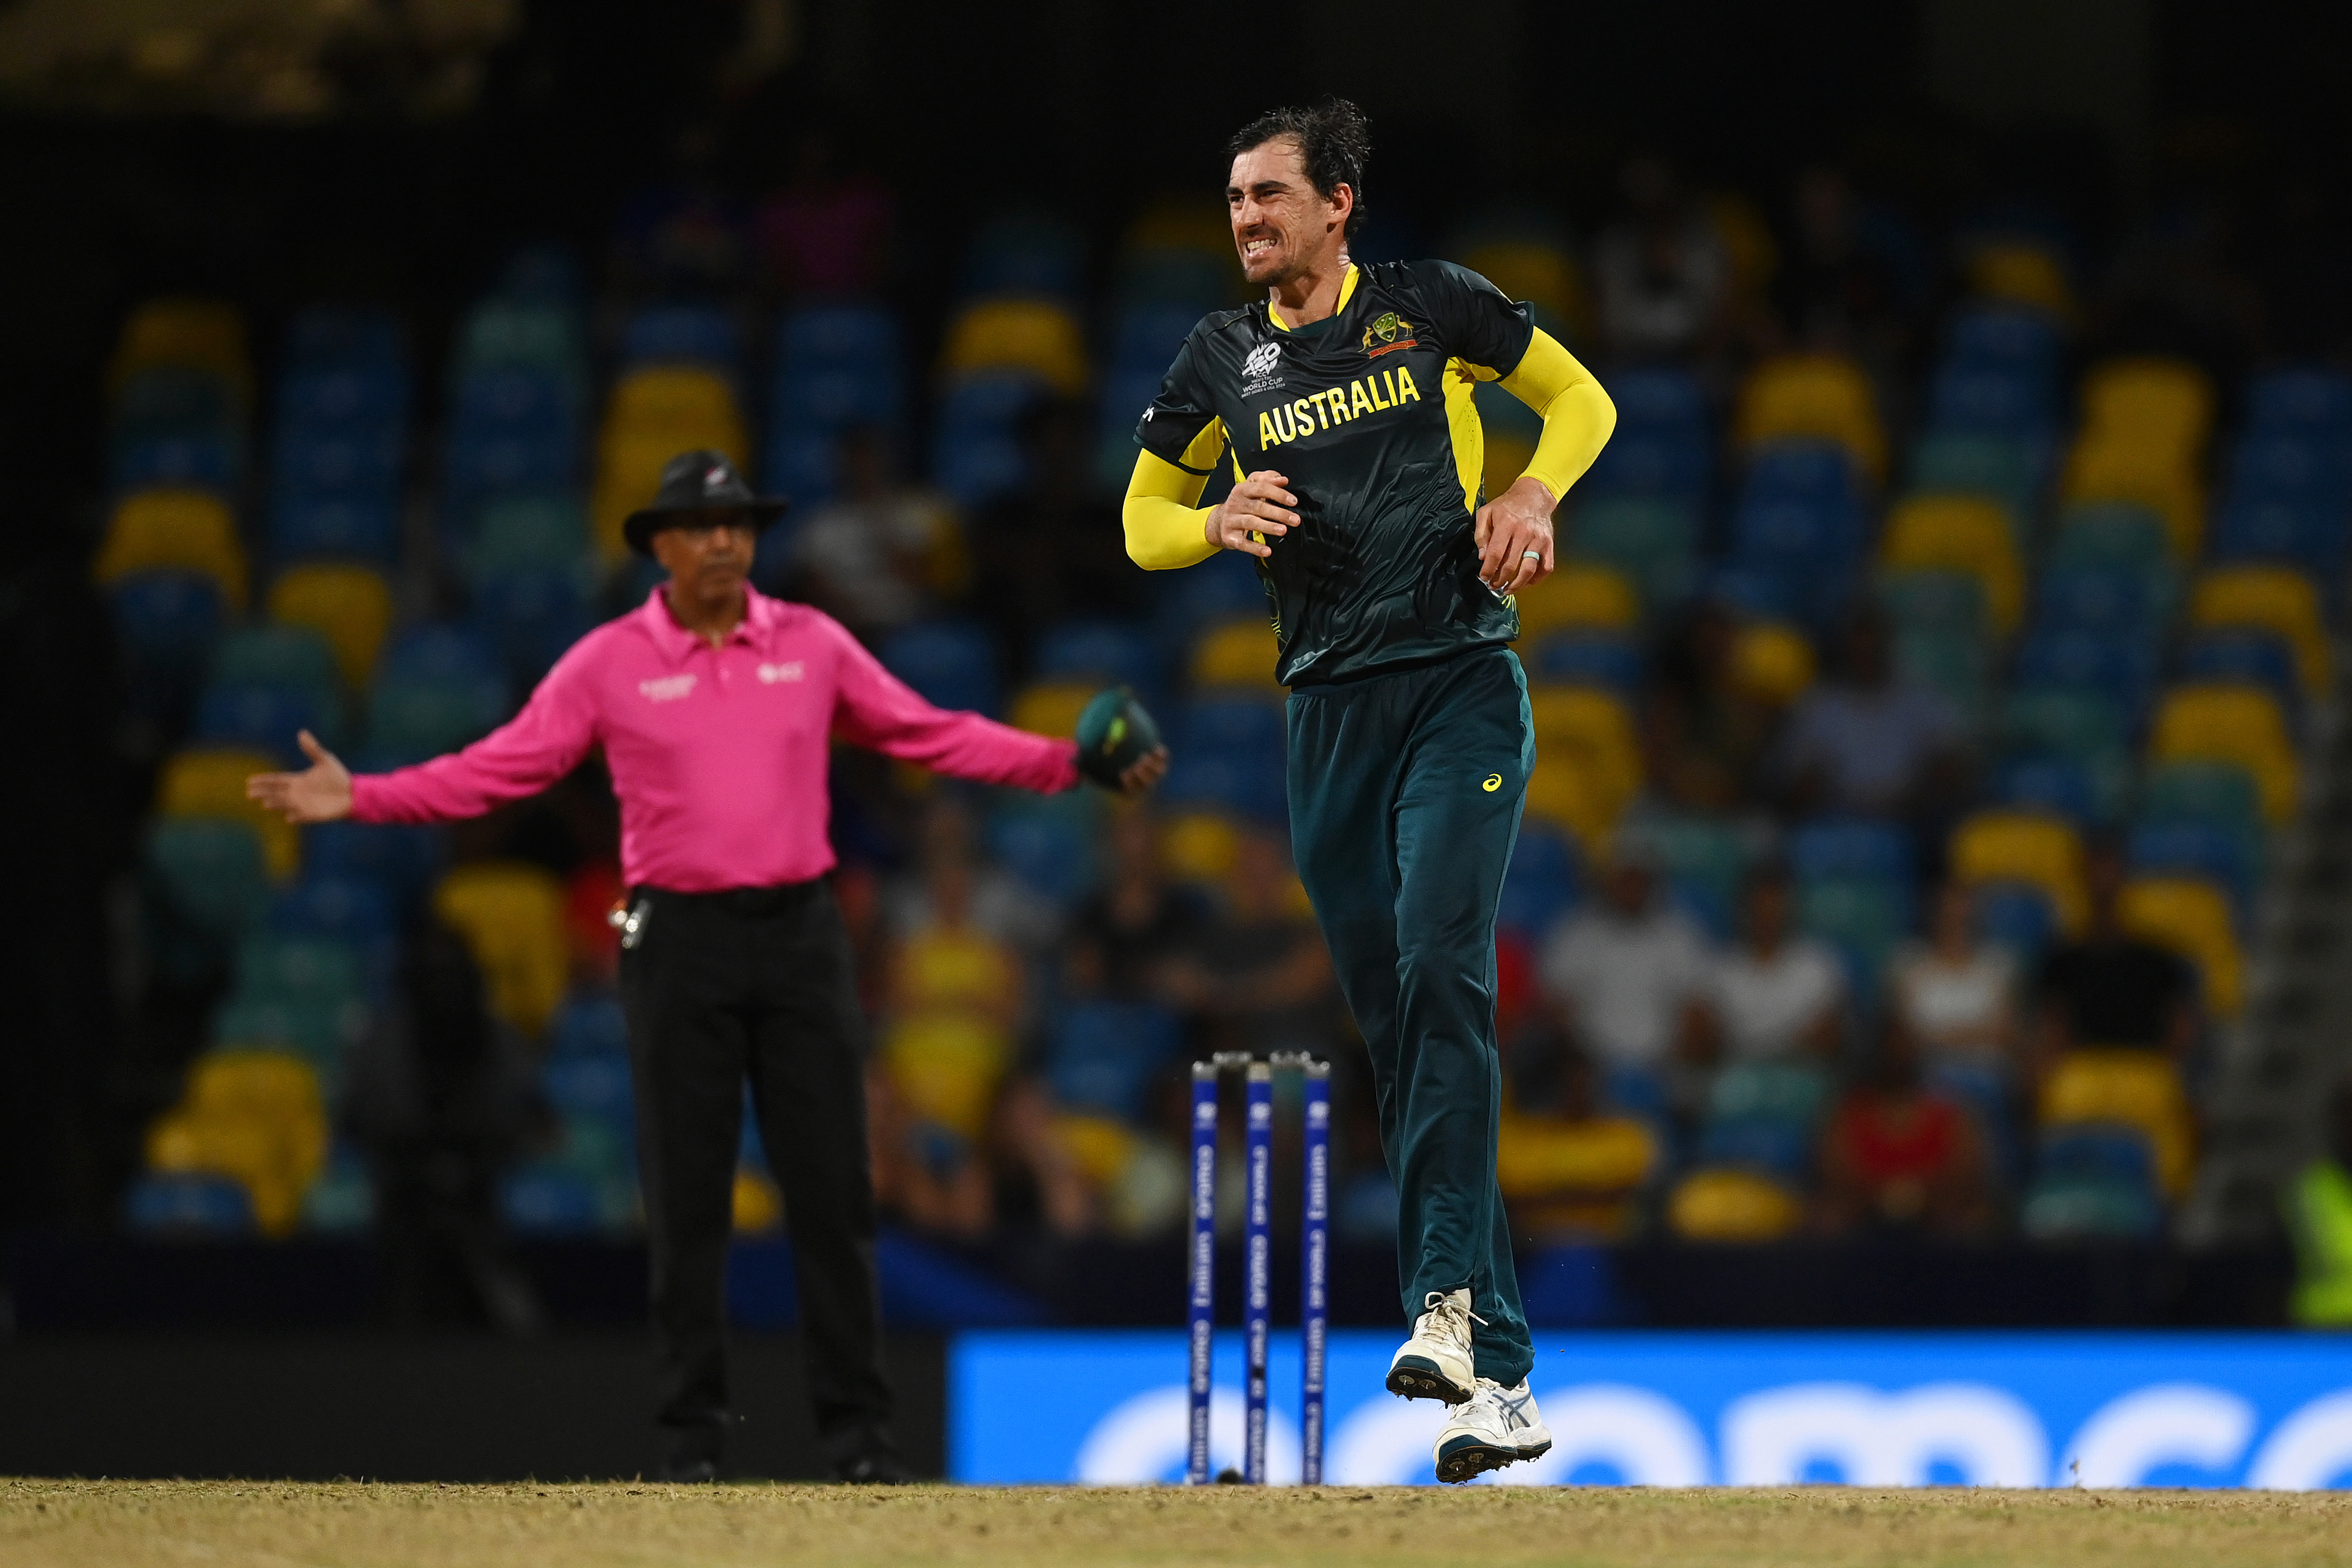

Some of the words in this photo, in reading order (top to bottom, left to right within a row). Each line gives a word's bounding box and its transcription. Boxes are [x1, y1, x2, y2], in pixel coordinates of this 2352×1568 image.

[1242, 381, 1267, 393] WORLD
[1268, 377, 1283, 386] CUP
[1258, 366, 1421, 451] AUSTRALIA
